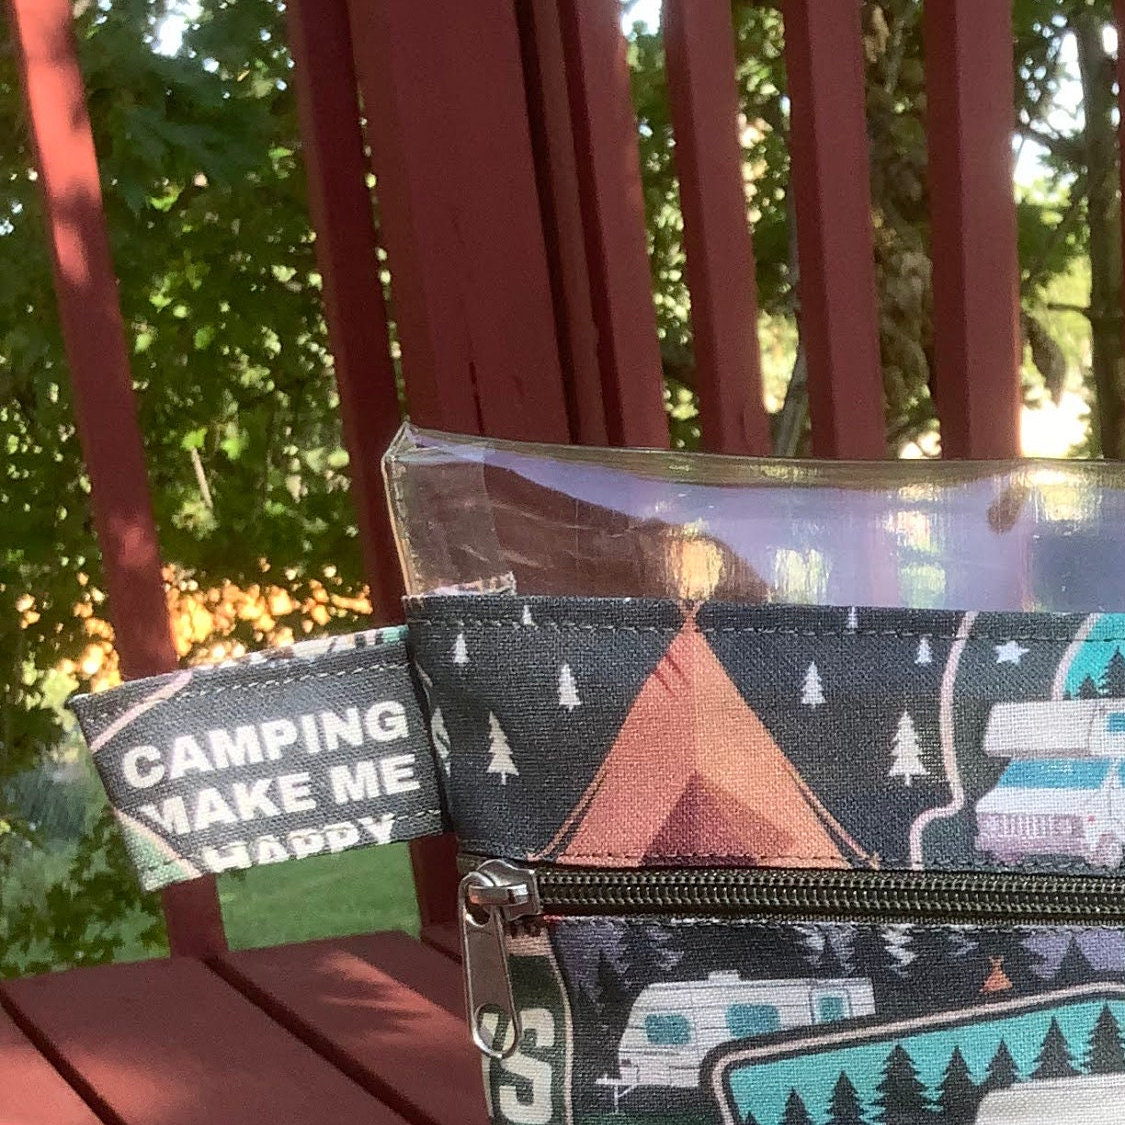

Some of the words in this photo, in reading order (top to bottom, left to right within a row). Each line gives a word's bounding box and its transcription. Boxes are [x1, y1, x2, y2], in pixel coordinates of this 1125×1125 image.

[121, 700, 411, 790] CAMPING
[138, 771, 317, 837] MAKE
[329, 754, 421, 804] ME
